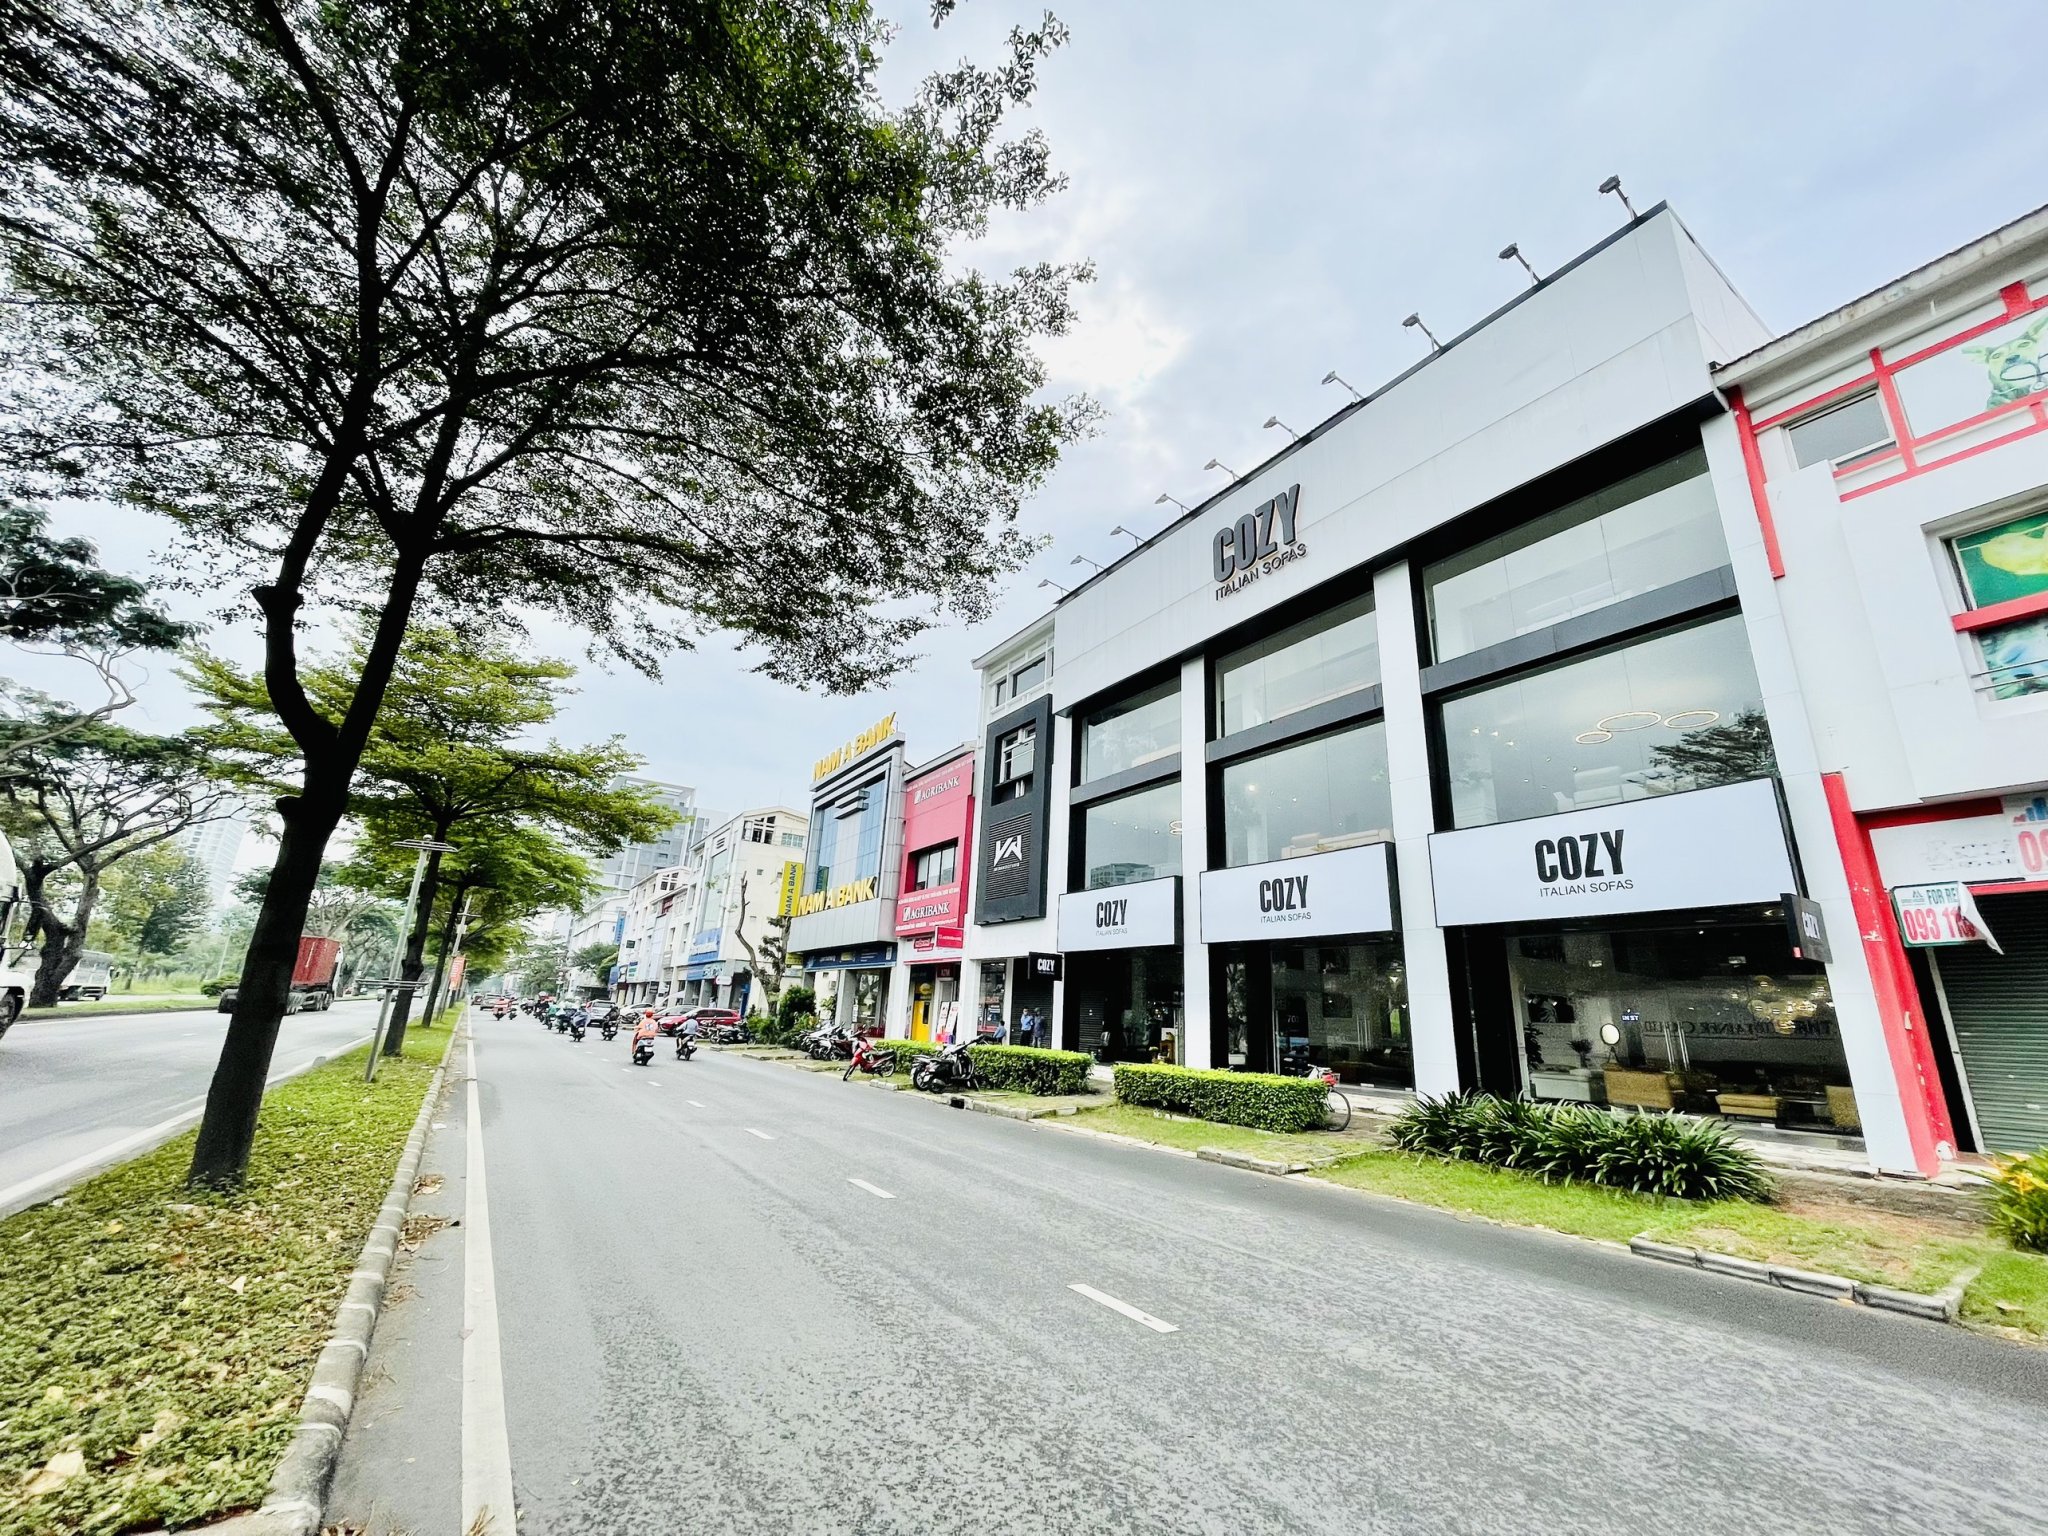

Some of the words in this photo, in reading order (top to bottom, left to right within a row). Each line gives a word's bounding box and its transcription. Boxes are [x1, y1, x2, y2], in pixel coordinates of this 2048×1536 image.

[1213, 483, 1300, 582] COZY
[1216, 567, 1259, 600] ITALIAN
[1263, 543, 1307, 575] SOFAS
[813, 747, 841, 780] NAM
[842, 741, 852, 764] A
[854, 711, 896, 757] BANK
[920, 776, 960, 801] AGRIBANK
[1535, 829, 1624, 883] COZY
[789, 863, 797, 886] BANK
[1540, 885, 1586, 897] ITALIAN
[1589, 879, 1633, 893] SOFAS
[798, 890, 826, 917] NAM
[825, 888, 835, 909] A
[836, 876, 877, 907] BANK
[1260, 875, 1308, 912] COZY
[1926, 889, 1944, 904] FOR
[910, 902, 949, 919] AGRIBANK
[1096, 899, 1127, 928] COZY
[1261, 915, 1286, 923] ITALIAN
[1288, 911, 1311, 922] SOFAS
[1903, 908, 1941, 940] 093
[1037, 958, 1055, 971] COZY
